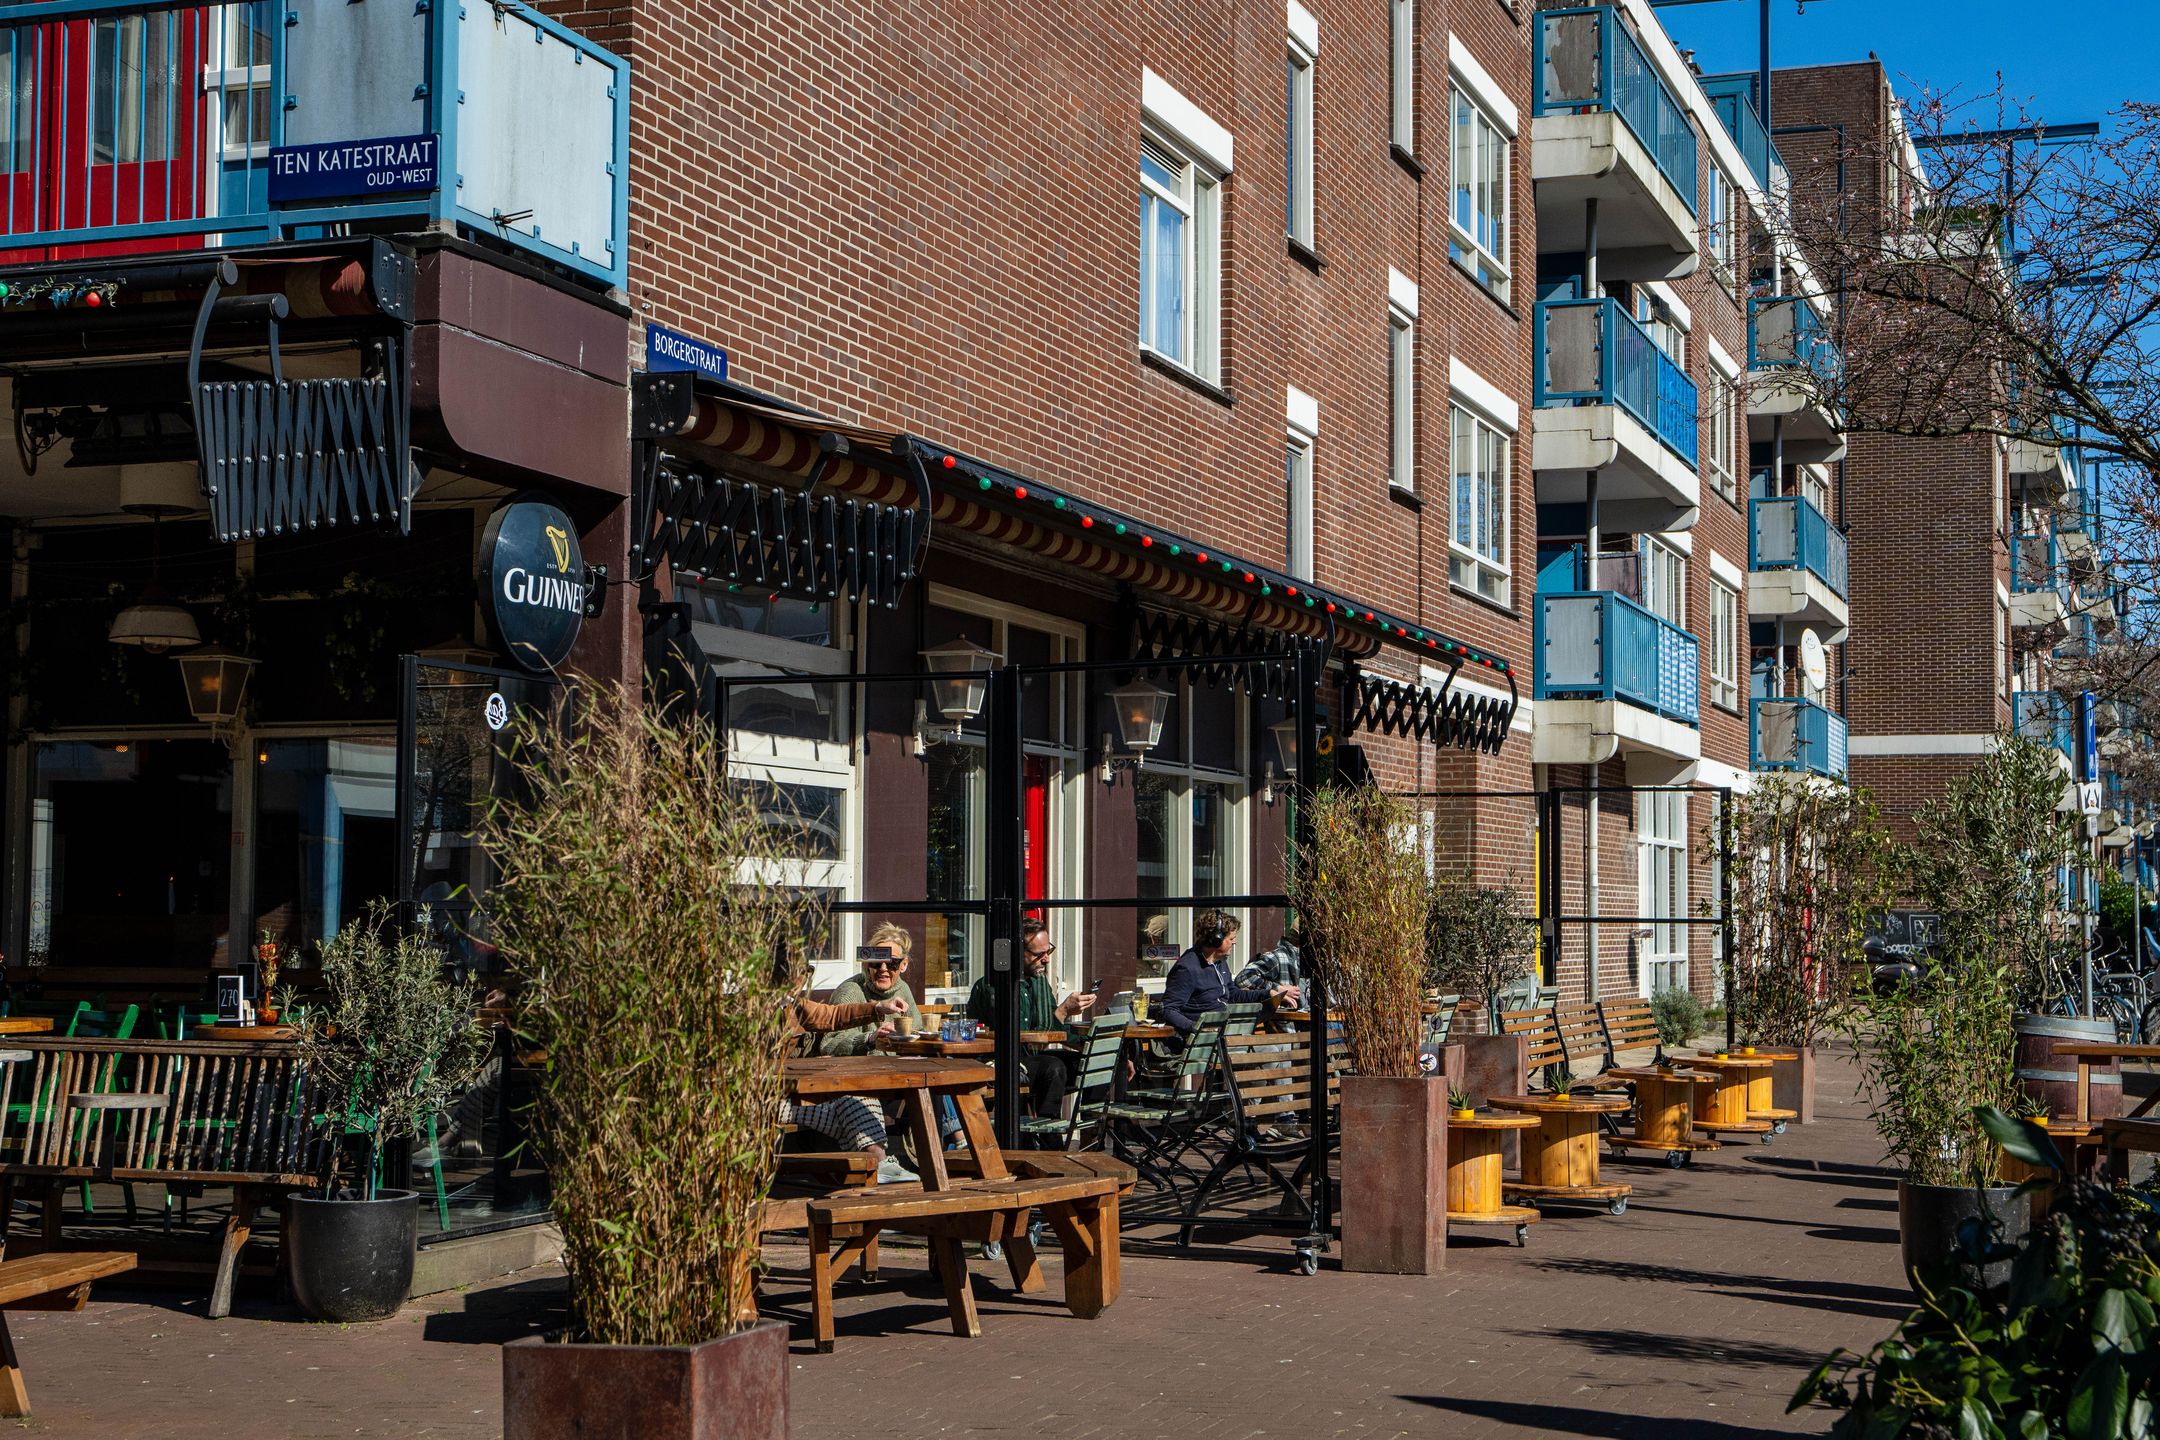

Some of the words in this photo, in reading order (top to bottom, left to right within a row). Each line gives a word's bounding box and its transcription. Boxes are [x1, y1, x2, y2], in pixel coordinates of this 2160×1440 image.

[273, 152, 310, 175] TEN
[318, 141, 433, 172] KATESTRAAT
[366, 168, 433, 186] OUD-WEST
[654, 332, 722, 374] BORGERSTRAAT
[503, 567, 584, 615] GUINNES
[220, 988, 239, 1007] 270
